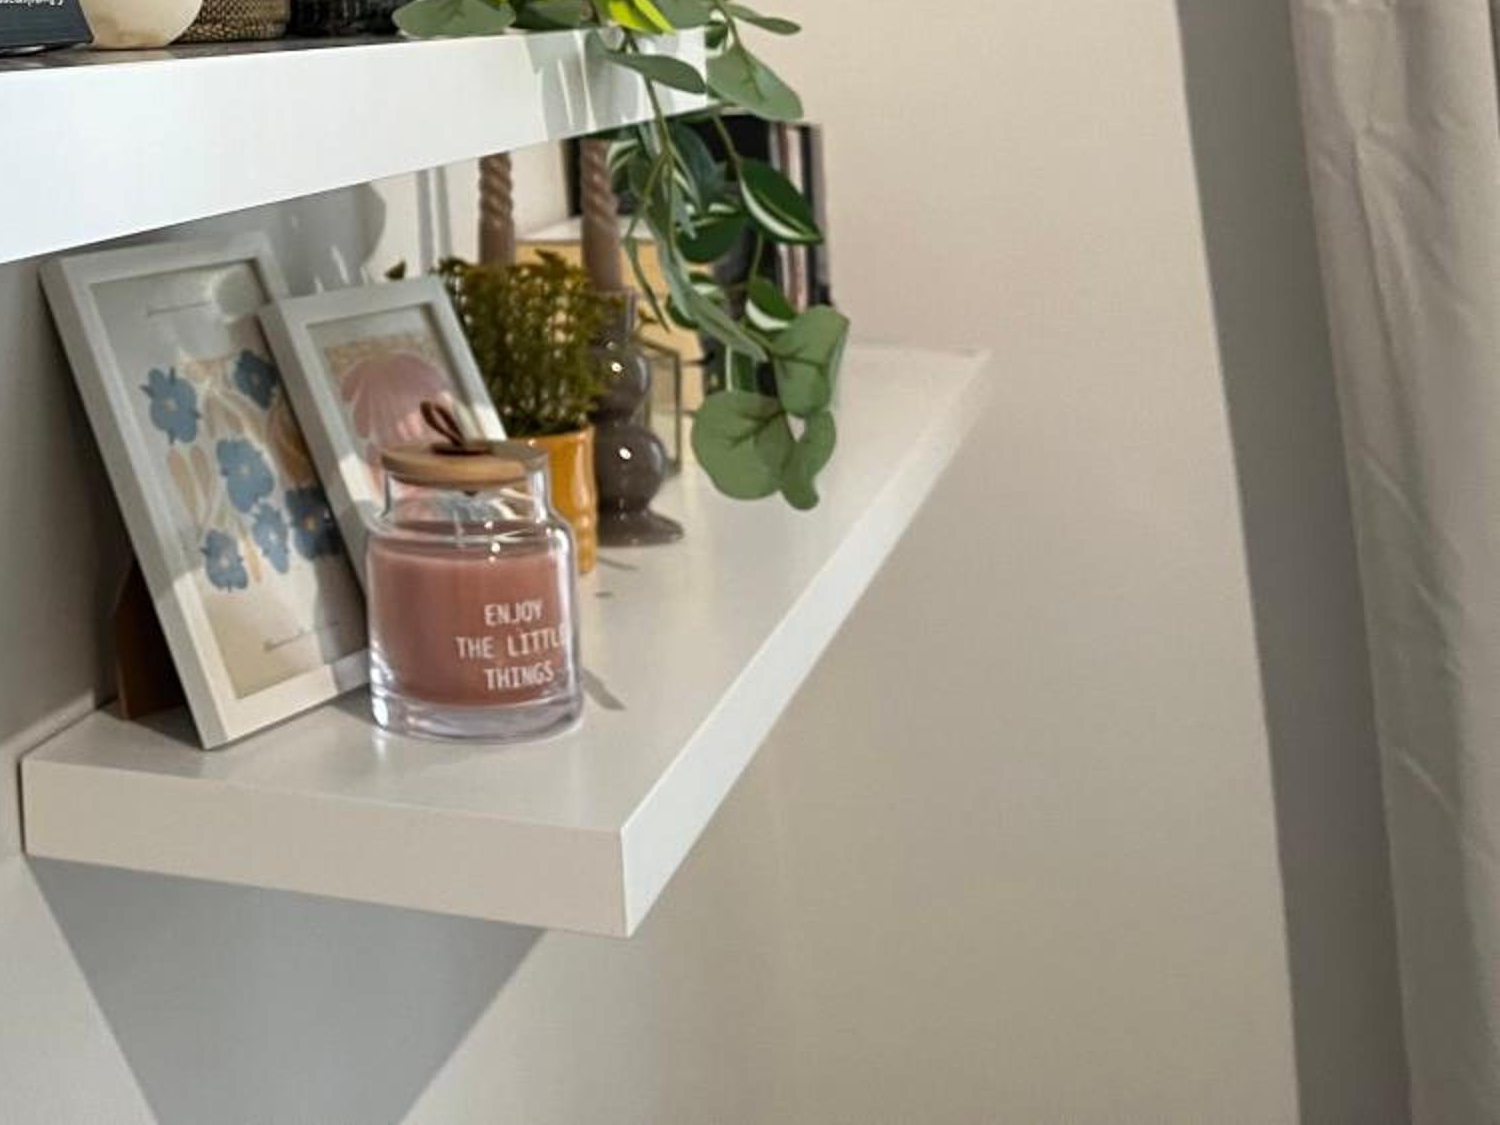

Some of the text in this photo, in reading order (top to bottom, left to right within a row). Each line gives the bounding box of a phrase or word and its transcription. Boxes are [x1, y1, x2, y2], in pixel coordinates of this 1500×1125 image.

[484, 598, 543, 626] ENJOY
[456, 636, 494, 659] THE
[484, 660, 554, 690] THINGS
